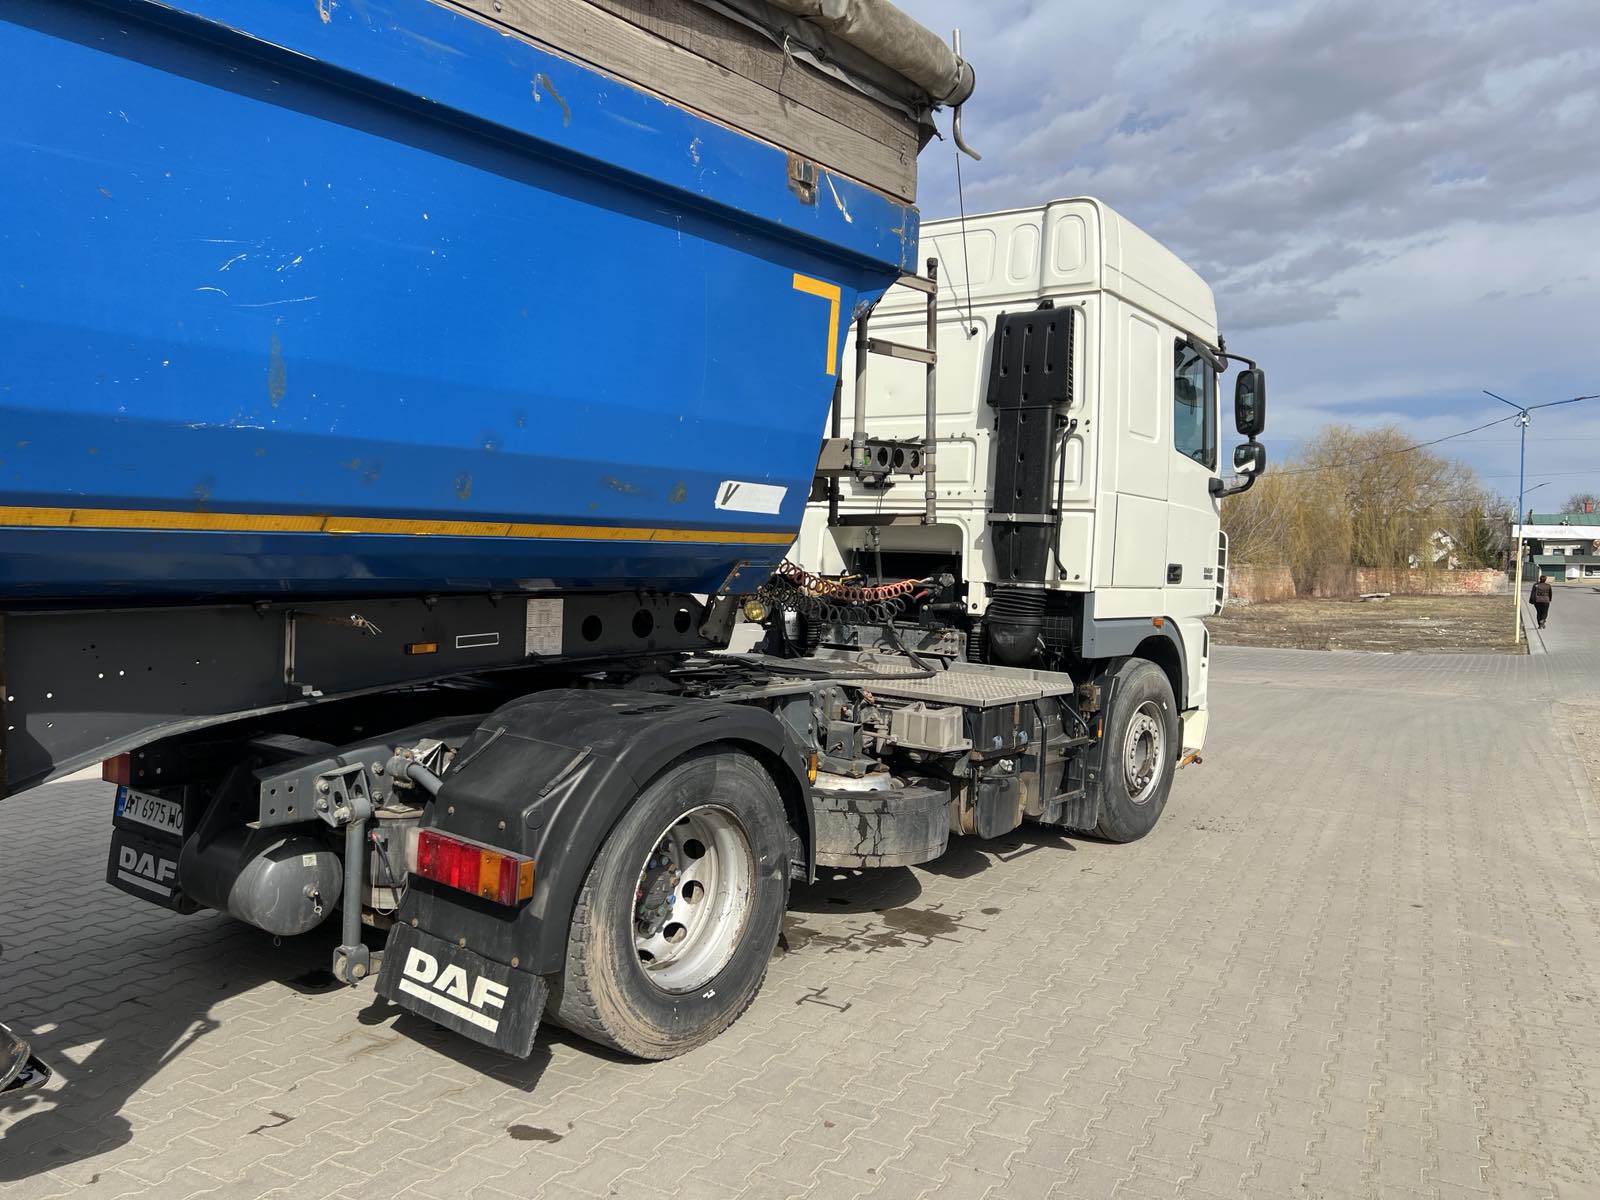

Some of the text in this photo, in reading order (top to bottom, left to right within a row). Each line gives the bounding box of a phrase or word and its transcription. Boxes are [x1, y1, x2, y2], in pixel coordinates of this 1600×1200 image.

[124, 794, 183, 829] AT 6975 HO
[119, 845, 177, 881] DAF
[403, 947, 509, 1009] DAF
